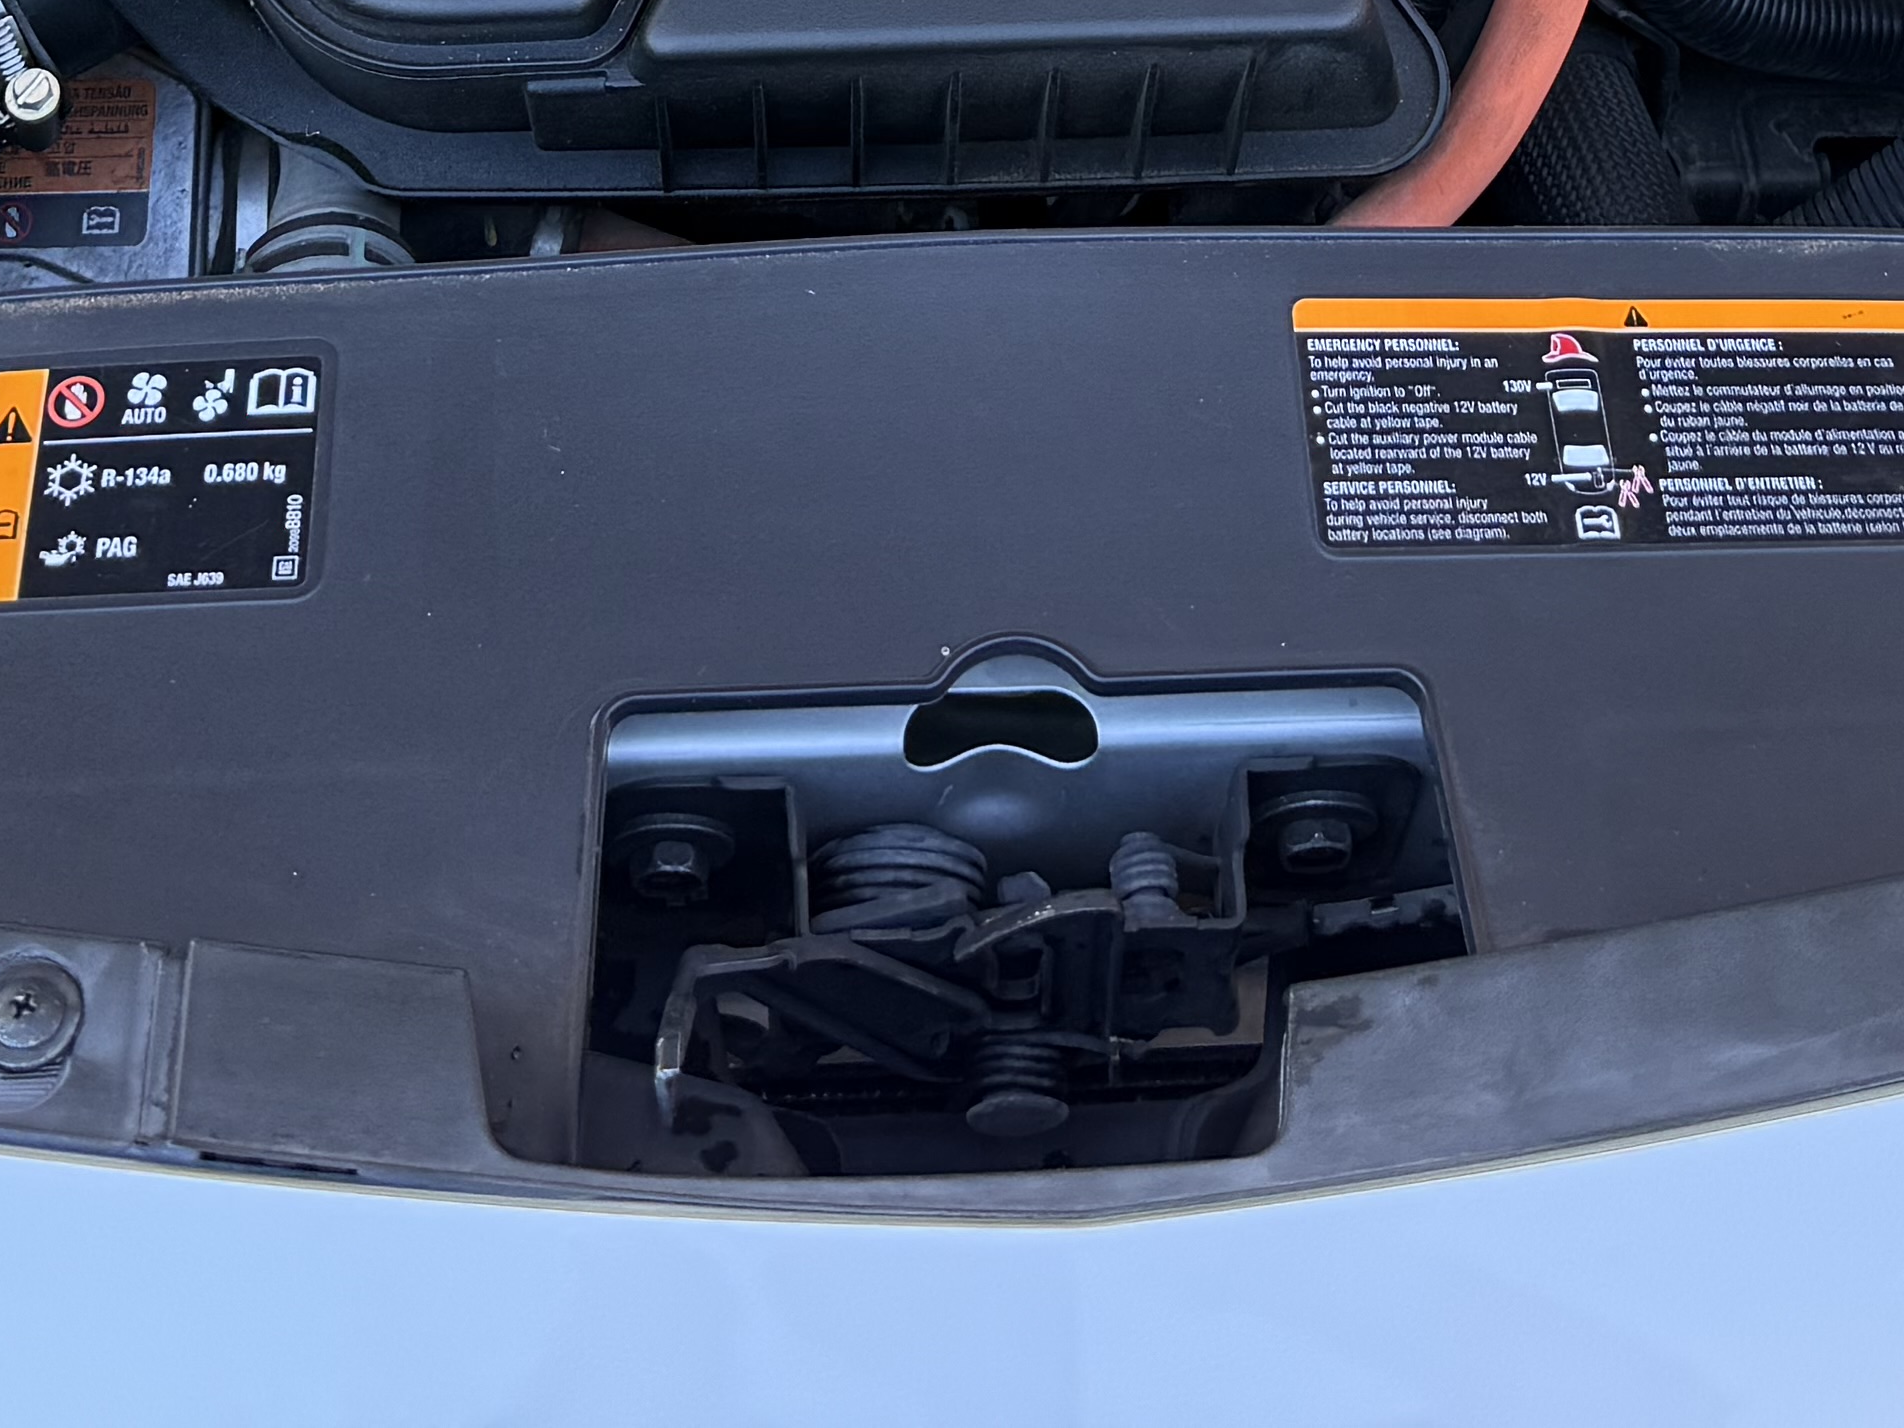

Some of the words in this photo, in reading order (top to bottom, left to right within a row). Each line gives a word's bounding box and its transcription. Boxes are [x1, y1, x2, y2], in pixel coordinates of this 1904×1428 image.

[1307, 339, 1381, 351] EMERGENCY
[1384, 339, 1459, 351] PERSONNEL:
[1633, 338, 1705, 352] PERSONNEL
[1707, 338, 1776, 352] D'URGENCE
[1308, 356, 1320, 367] To
[1324, 356, 1347, 369] help
[1352, 356, 1382, 367] avoid
[1386, 356, 1433, 370] personal
[1436, 355, 1467, 370] injury
[1470, 356, 1481, 367] in
[1484, 357, 1499, 367] an
[1321, 386, 1345, 397] Turn
[1349, 385, 1390, 399] ignition
[1394, 386, 1405, 396] to
[1503, 380, 1531, 393] 130V
[1324, 401, 1344, 413] Cut
[1347, 401, 1365, 413] the
[1368, 401, 1399, 414] black
[1402, 401, 1450, 415] negative
[1454, 401, 1475, 413] 12V
[1478, 401, 1518, 415] battery
[121, 406, 167, 425] AUTO
[1327, 417, 1356, 428] cable
[1360, 417, 1372, 428] at
[1375, 417, 1411, 430] yellow
[1328, 432, 1348, 444] Cut
[1351, 432, 1369, 444] the
[1373, 432, 1419, 446] auxiliary
[1424, 433, 1458, 446] power
[1462, 431, 1503, 444] module
[1507, 431, 1538, 444] cable
[1330, 447, 1371, 460] located
[1376, 447, 1426, 459] rearward
[1430, 446, 1441, 458] of
[1444, 446, 1462, 458] the
[1466, 445, 1487, 458] 12V
[1490, 445, 1530, 460] battery
[101, 466, 171, 488] R-134a
[203, 461, 259, 484] 0.680
[262, 461, 287, 484] kg
[1332, 463, 1344, 474] at
[1346, 462, 1383, 476] yellow
[1524, 473, 1546, 485] 12V
[1659, 478, 1733, 492] PERSONNEL
[1323, 481, 1376, 494] SERVICE
[1378, 480, 1456, 494] PERSONNEL:
[1323, 498, 1338, 510] To
[1341, 497, 1365, 511] help
[1369, 496, 1399, 510] avoid
[1403, 497, 1453, 511] personal
[1456, 496, 1487, 511] injury
[1326, 513, 1363, 527] during
[1366, 512, 1406, 524] vehicle
[1458, 511, 1519, 524] disconnect
[1522, 510, 1548, 523] both
[1327, 529, 1368, 543] battery
[1372, 528, 1425, 541] locations
[95, 535, 138, 559] PAG
[167, 573, 193, 587] SAE
[193, 572, 225, 586] J639
